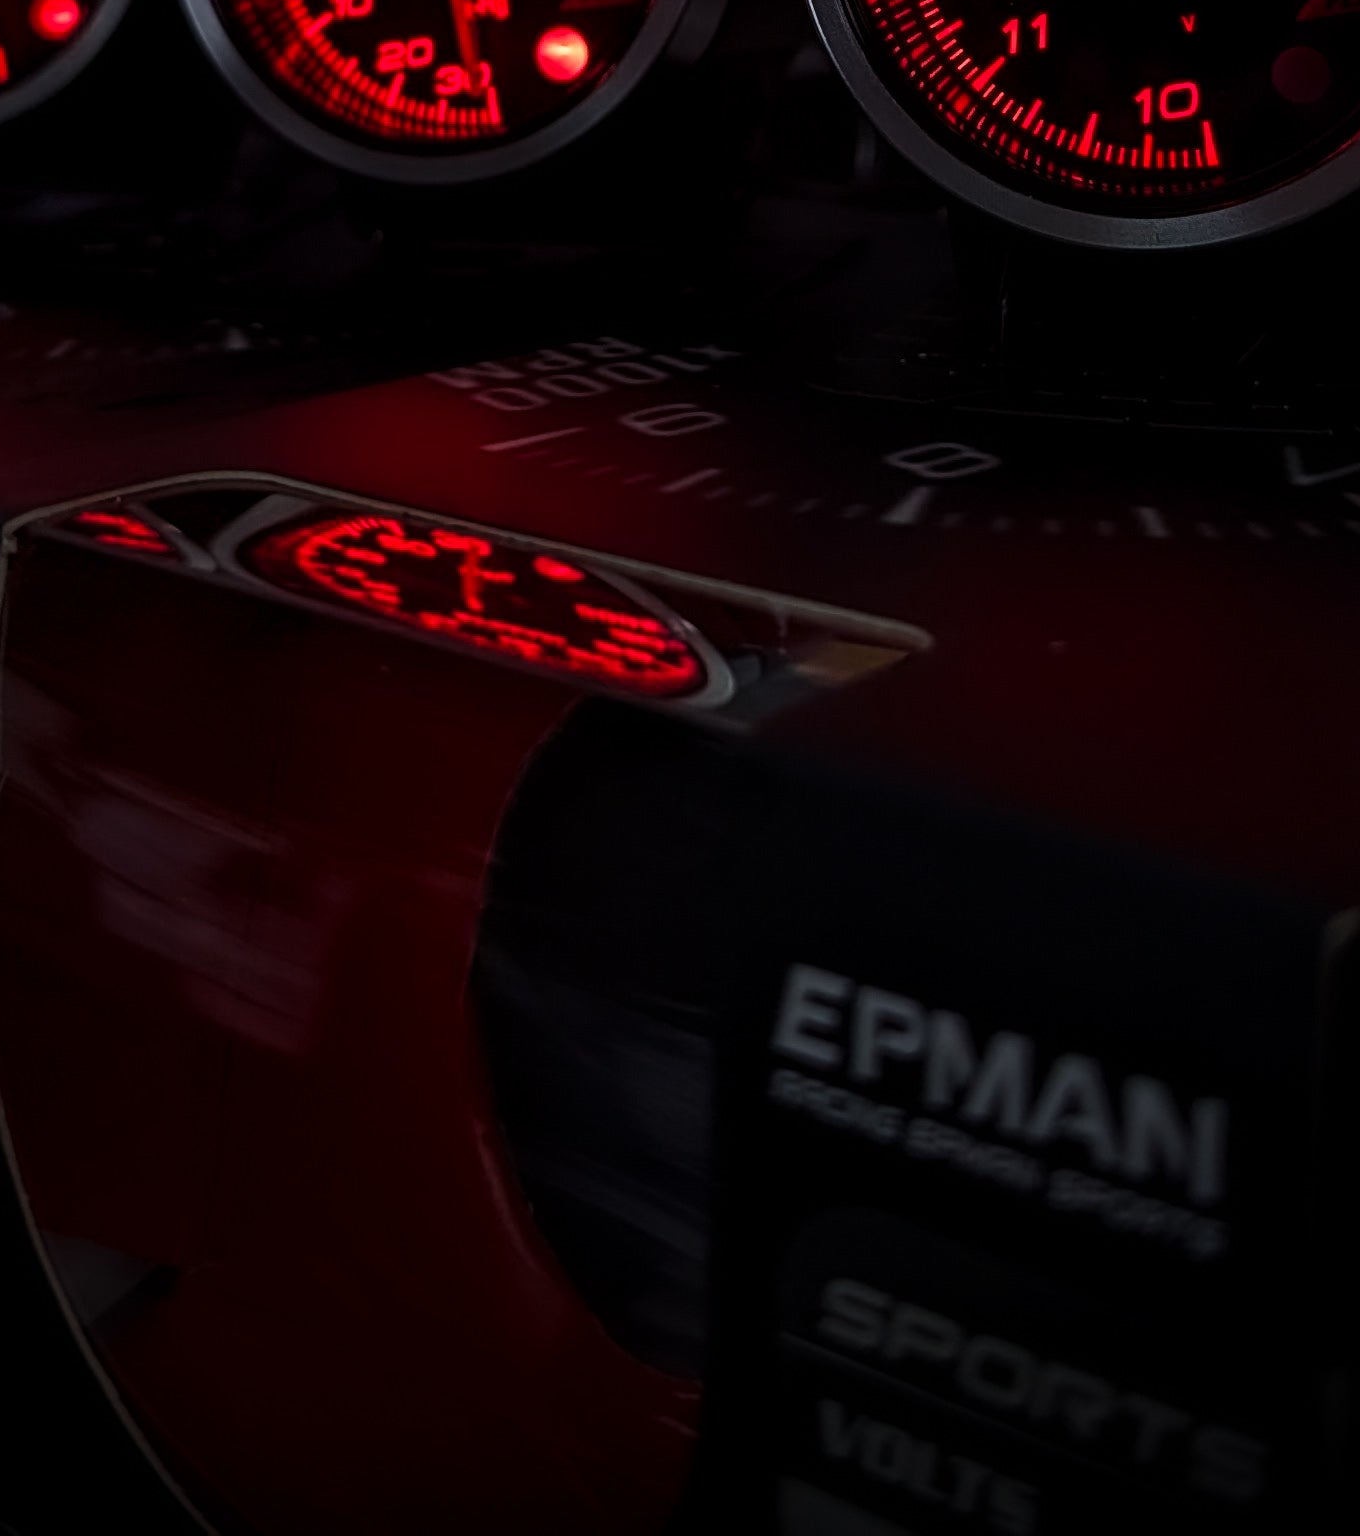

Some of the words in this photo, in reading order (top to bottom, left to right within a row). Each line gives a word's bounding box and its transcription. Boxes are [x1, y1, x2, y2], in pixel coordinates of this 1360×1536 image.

[376, 37, 434, 72] 20
[1001, 14, 1050, 54] 11
[1134, 80, 1199, 124] 10
[767, 963, 1230, 1208] EPMAN
[816, 1277, 1271, 1504] SPORTS
[816, 1398, 1040, 1535] VOLTS
